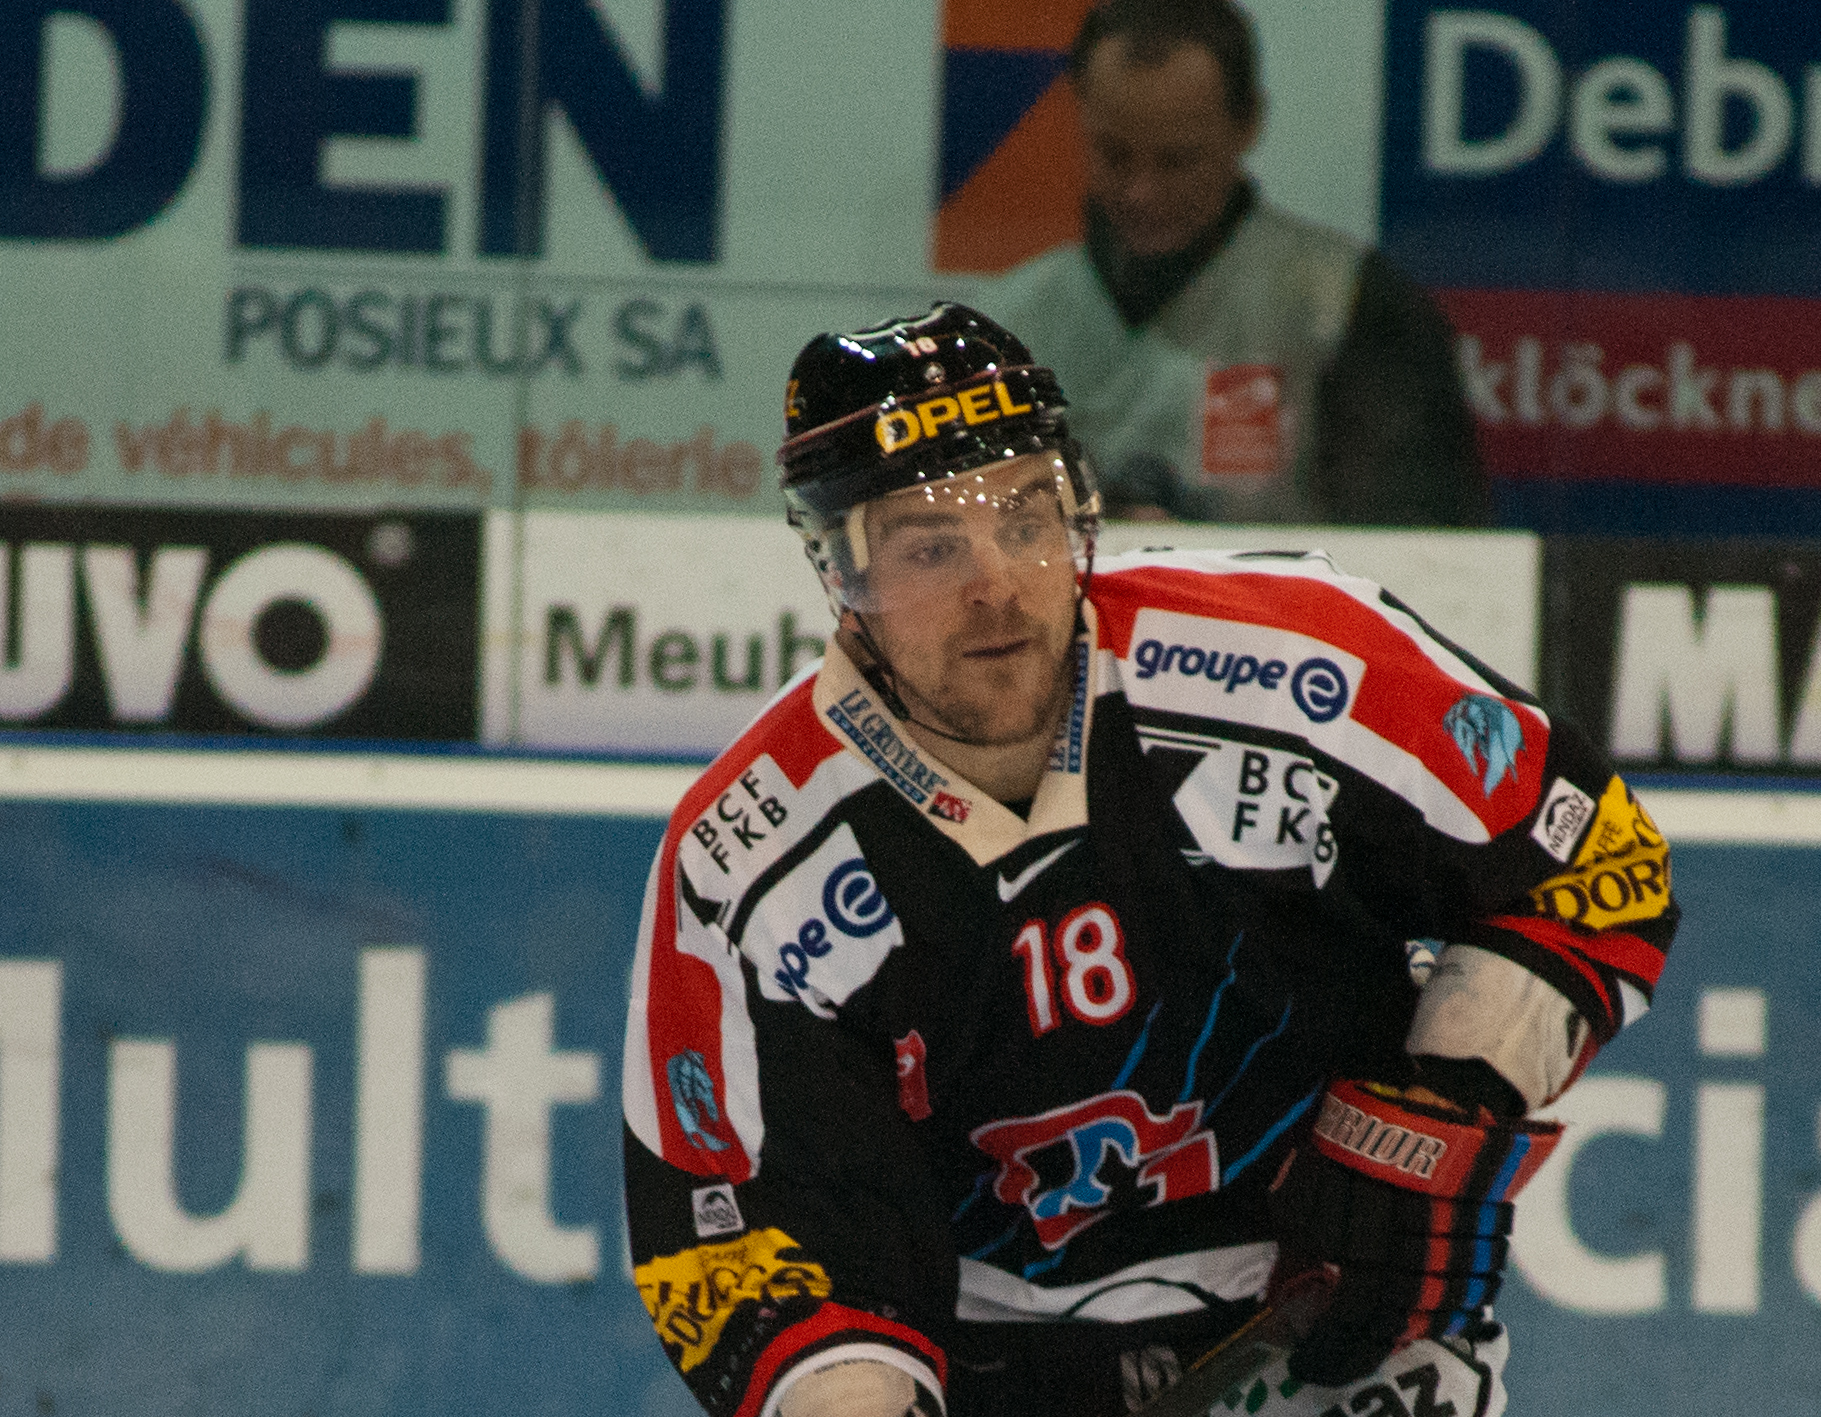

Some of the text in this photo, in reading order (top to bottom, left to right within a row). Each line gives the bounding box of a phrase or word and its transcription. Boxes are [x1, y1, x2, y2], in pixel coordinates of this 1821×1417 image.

[226, 287, 724, 383] POSIEUX SA
[875, 381, 1032, 457] OPEL
[1135, 638, 1288, 695] groupe
[1239, 750, 1331, 803] BC
[1012, 905, 1135, 1035] 18
[0, 946, 602, 1284] ult
[1507, 988, 1821, 1316] ci
